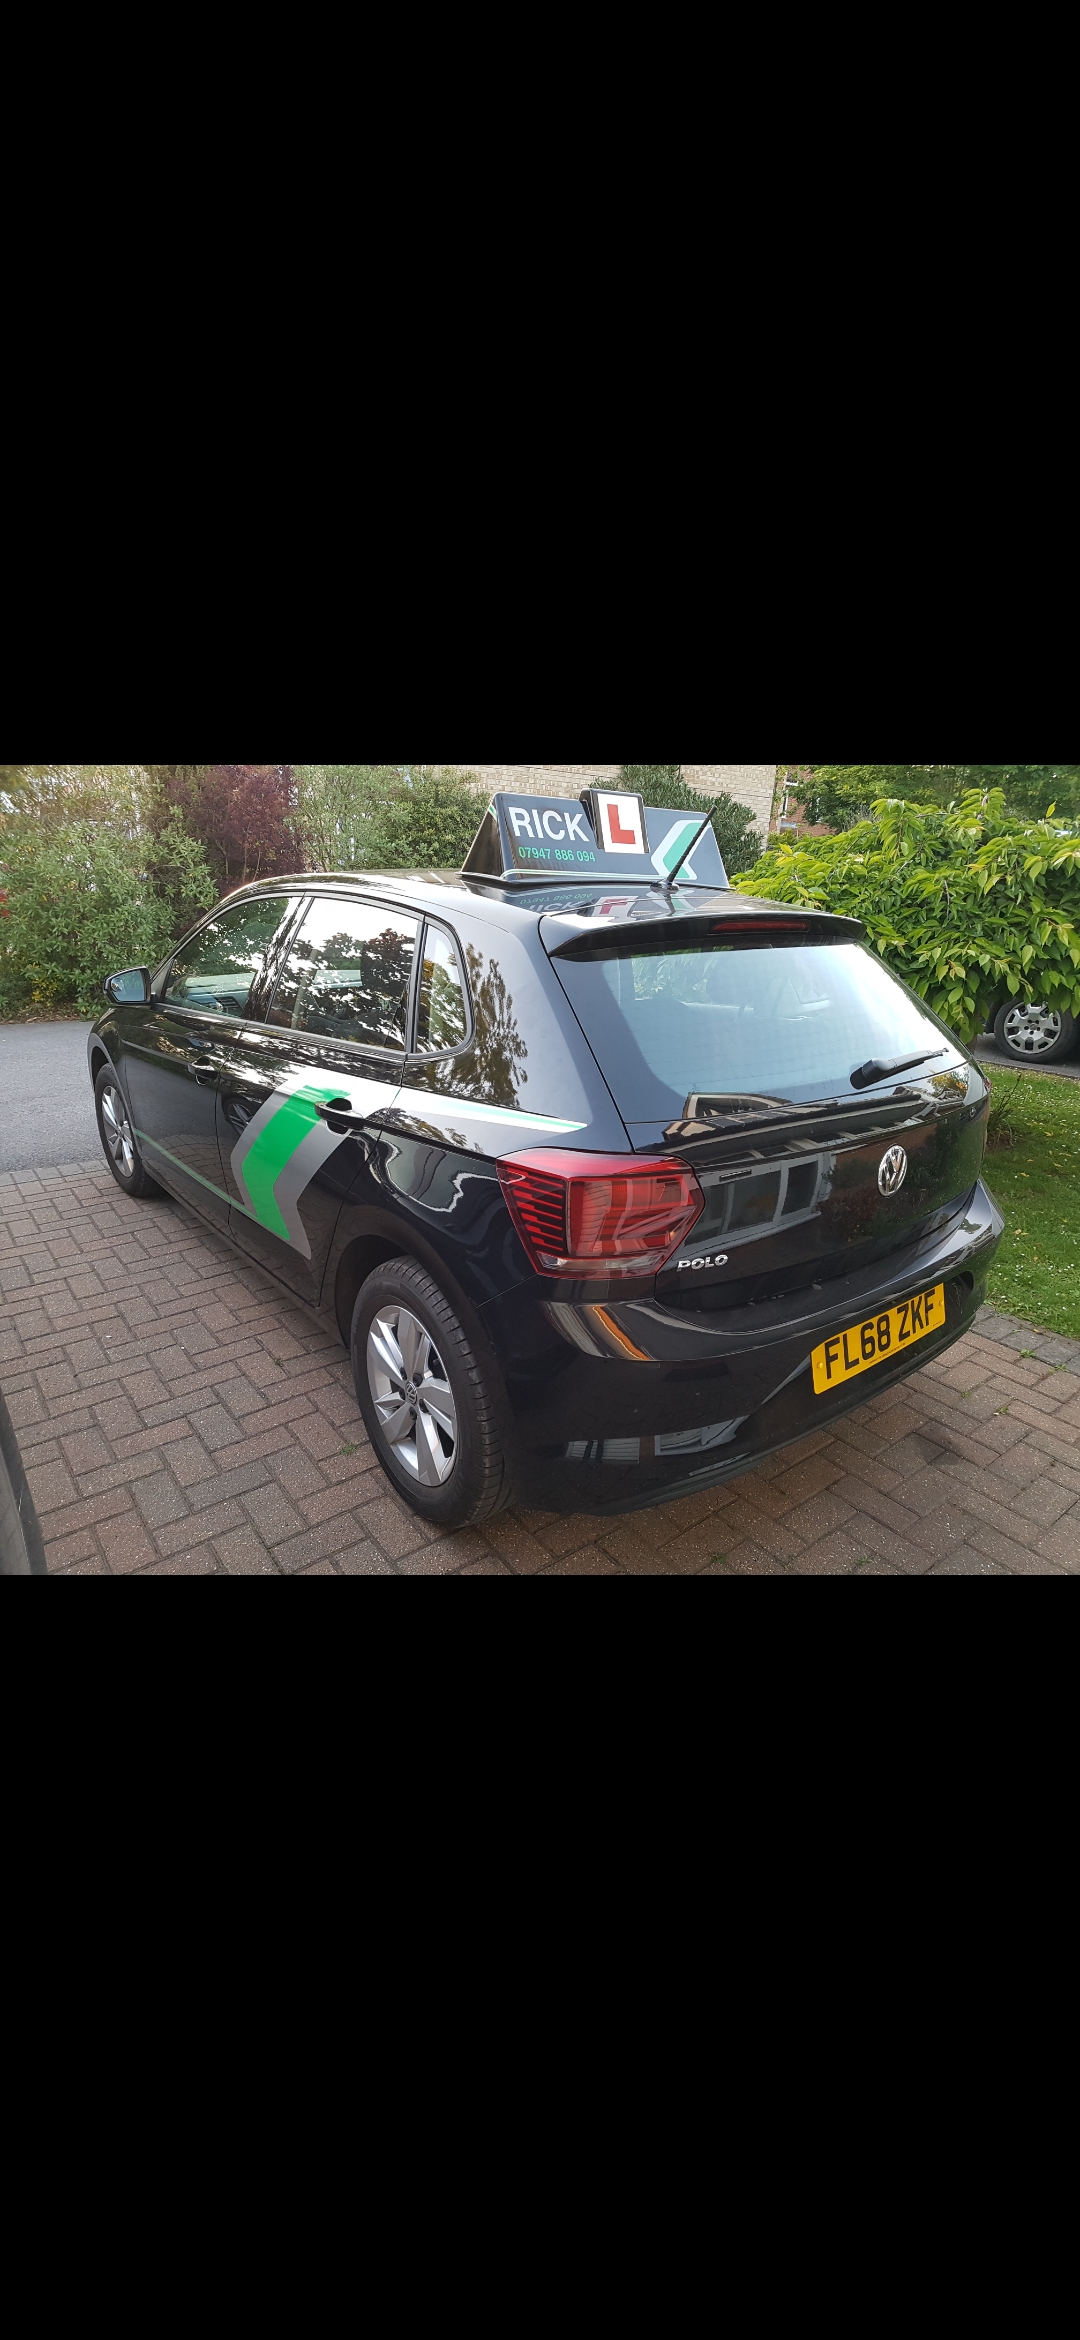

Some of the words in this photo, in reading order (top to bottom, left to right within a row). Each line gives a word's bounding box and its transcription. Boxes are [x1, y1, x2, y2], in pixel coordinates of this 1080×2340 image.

[508, 806, 589, 841] RICK
[607, 804, 636, 844] L
[518, 847, 551, 859] 07947
[554, 849, 575, 861] 886
[576, 850, 596, 862] 094
[677, 1255, 729, 1271] POLO
[824, 1317, 892, 1379] FL68
[896, 1291, 936, 1342] ZKF
